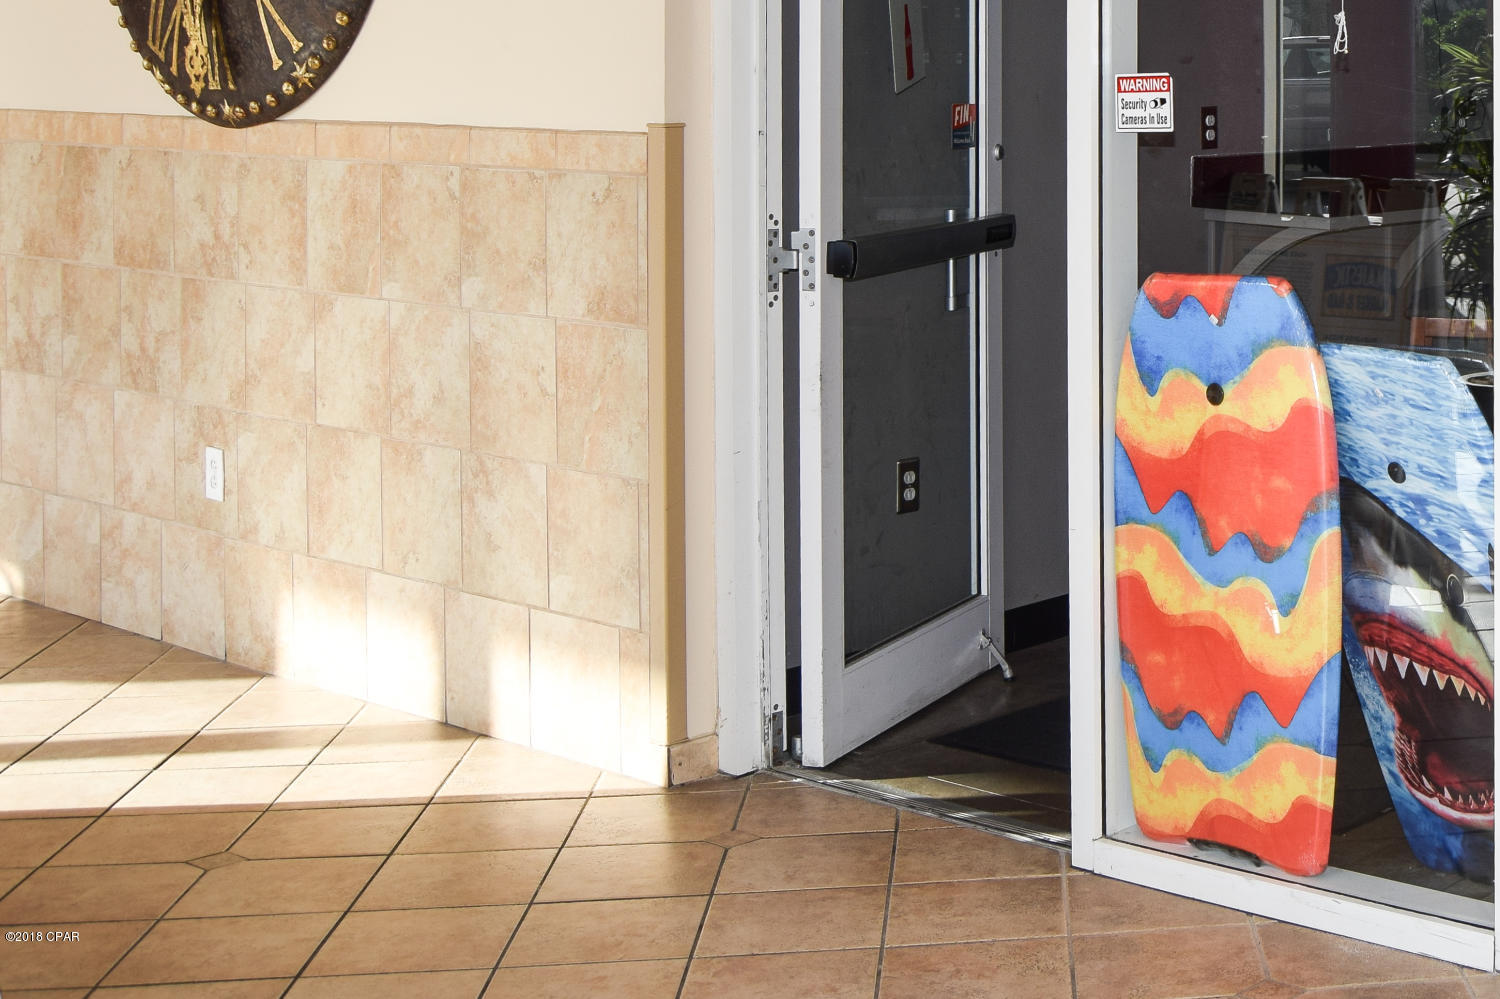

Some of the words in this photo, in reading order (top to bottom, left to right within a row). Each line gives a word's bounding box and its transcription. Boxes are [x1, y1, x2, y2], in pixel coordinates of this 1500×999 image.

[1120, 78, 1168, 92] WARNING
[1121, 97, 1147, 112] Security
[1121, 113, 1147, 125] Cameras
[1149, 113, 1155, 125] In
[1156, 113, 1168, 125] Use
